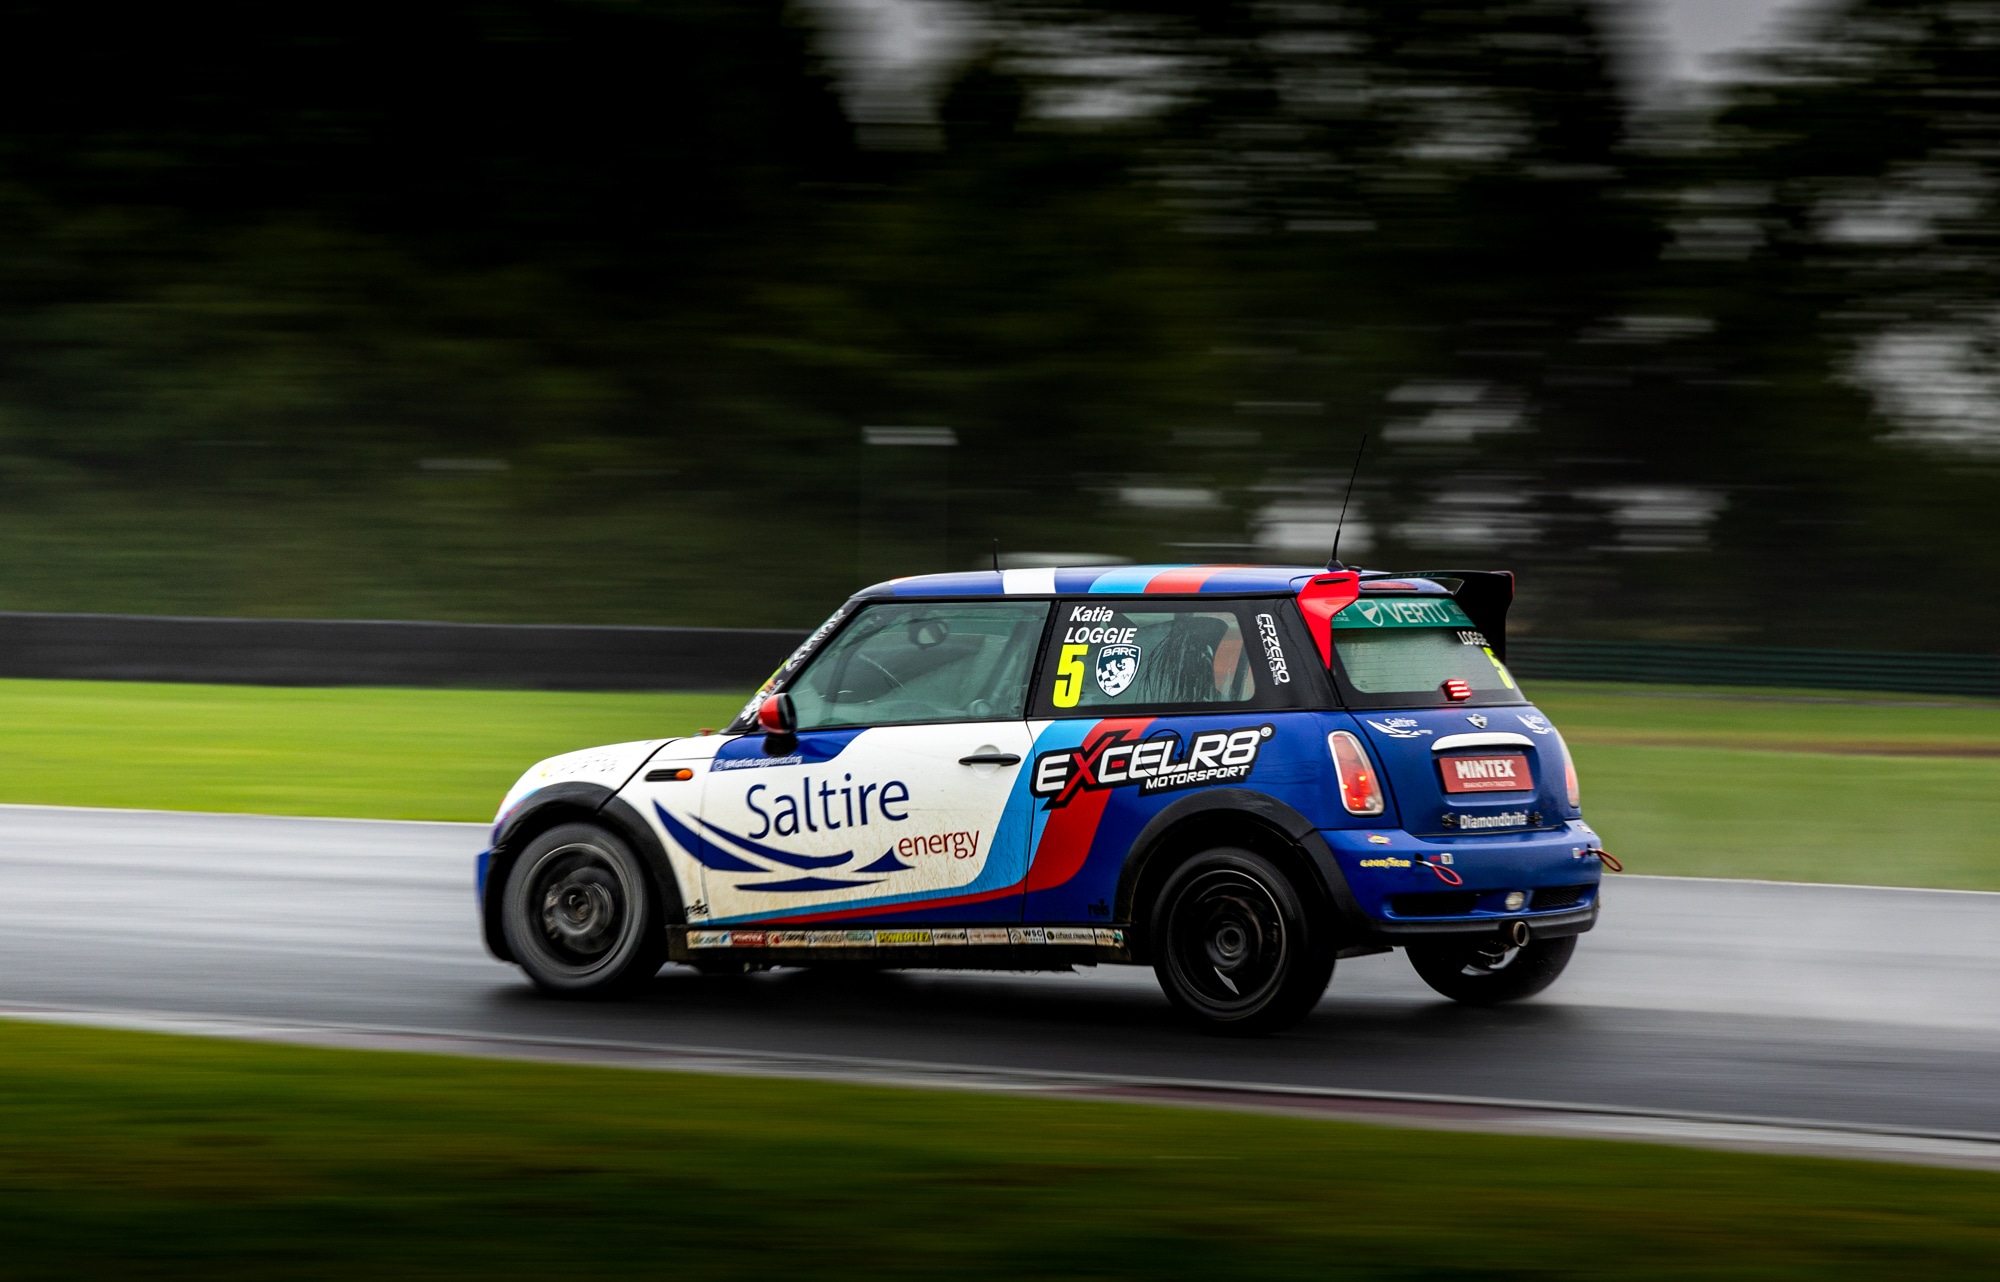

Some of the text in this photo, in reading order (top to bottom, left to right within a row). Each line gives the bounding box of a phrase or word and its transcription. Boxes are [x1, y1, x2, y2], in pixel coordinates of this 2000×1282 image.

[1069, 606, 1114, 622] Katia
[1380, 602, 1450, 624] VERTU
[1063, 627, 1138, 644] LOGGIE
[1102, 647, 1137, 658] BARC
[1052, 644, 1089, 708] 5
[1036, 729, 1261, 803] EXCELR8
[1455, 759, 1516, 780] MINTEX
[1145, 765, 1250, 790] MOTORSPORT
[746, 773, 910, 840] Saltire
[1459, 812, 1528, 830] Diamondbrite
[898, 830, 980, 860] energy
[1022, 930, 1043, 938] WSC
